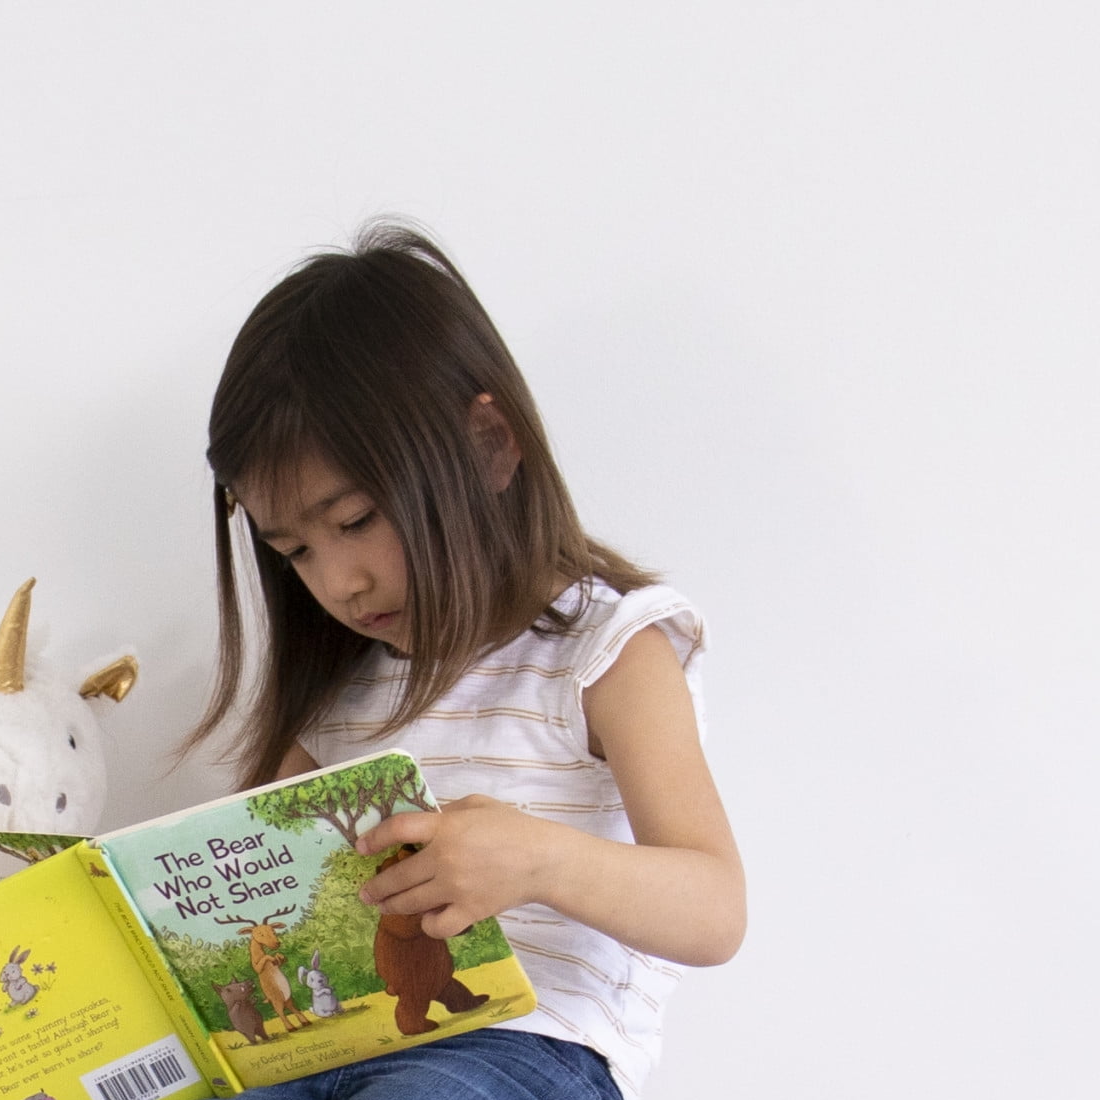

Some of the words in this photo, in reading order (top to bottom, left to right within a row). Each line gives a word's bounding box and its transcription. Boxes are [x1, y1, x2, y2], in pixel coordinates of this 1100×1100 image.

[154, 852, 204, 874] The
[207, 832, 265, 860] Bear
[154, 875, 212, 900] Who
[214, 844, 294, 882] Would
[175, 893, 225, 920] Not
[228, 875, 299, 904] Share
[10, 1034, 32, 1047] some
[34, 1018, 68, 1038] yummy
[52, 1020, 89, 1041] Although
[90, 1008, 111, 1024] Bear
[113, 1003, 123, 1014] is
[26, 1054, 39, 1067] not
[42, 1050, 53, 1059] so
[53, 1038, 72, 1057] good
[74, 1034, 84, 1045] at
[295, 1038, 335, 1055] Graham
[0, 1080, 21, 1096] Bear
[22, 1072, 41, 1085] ever
[43, 1061, 65, 1077] learn
[65, 1055, 76, 1065] to
[76, 1040, 104, 1060] share?
